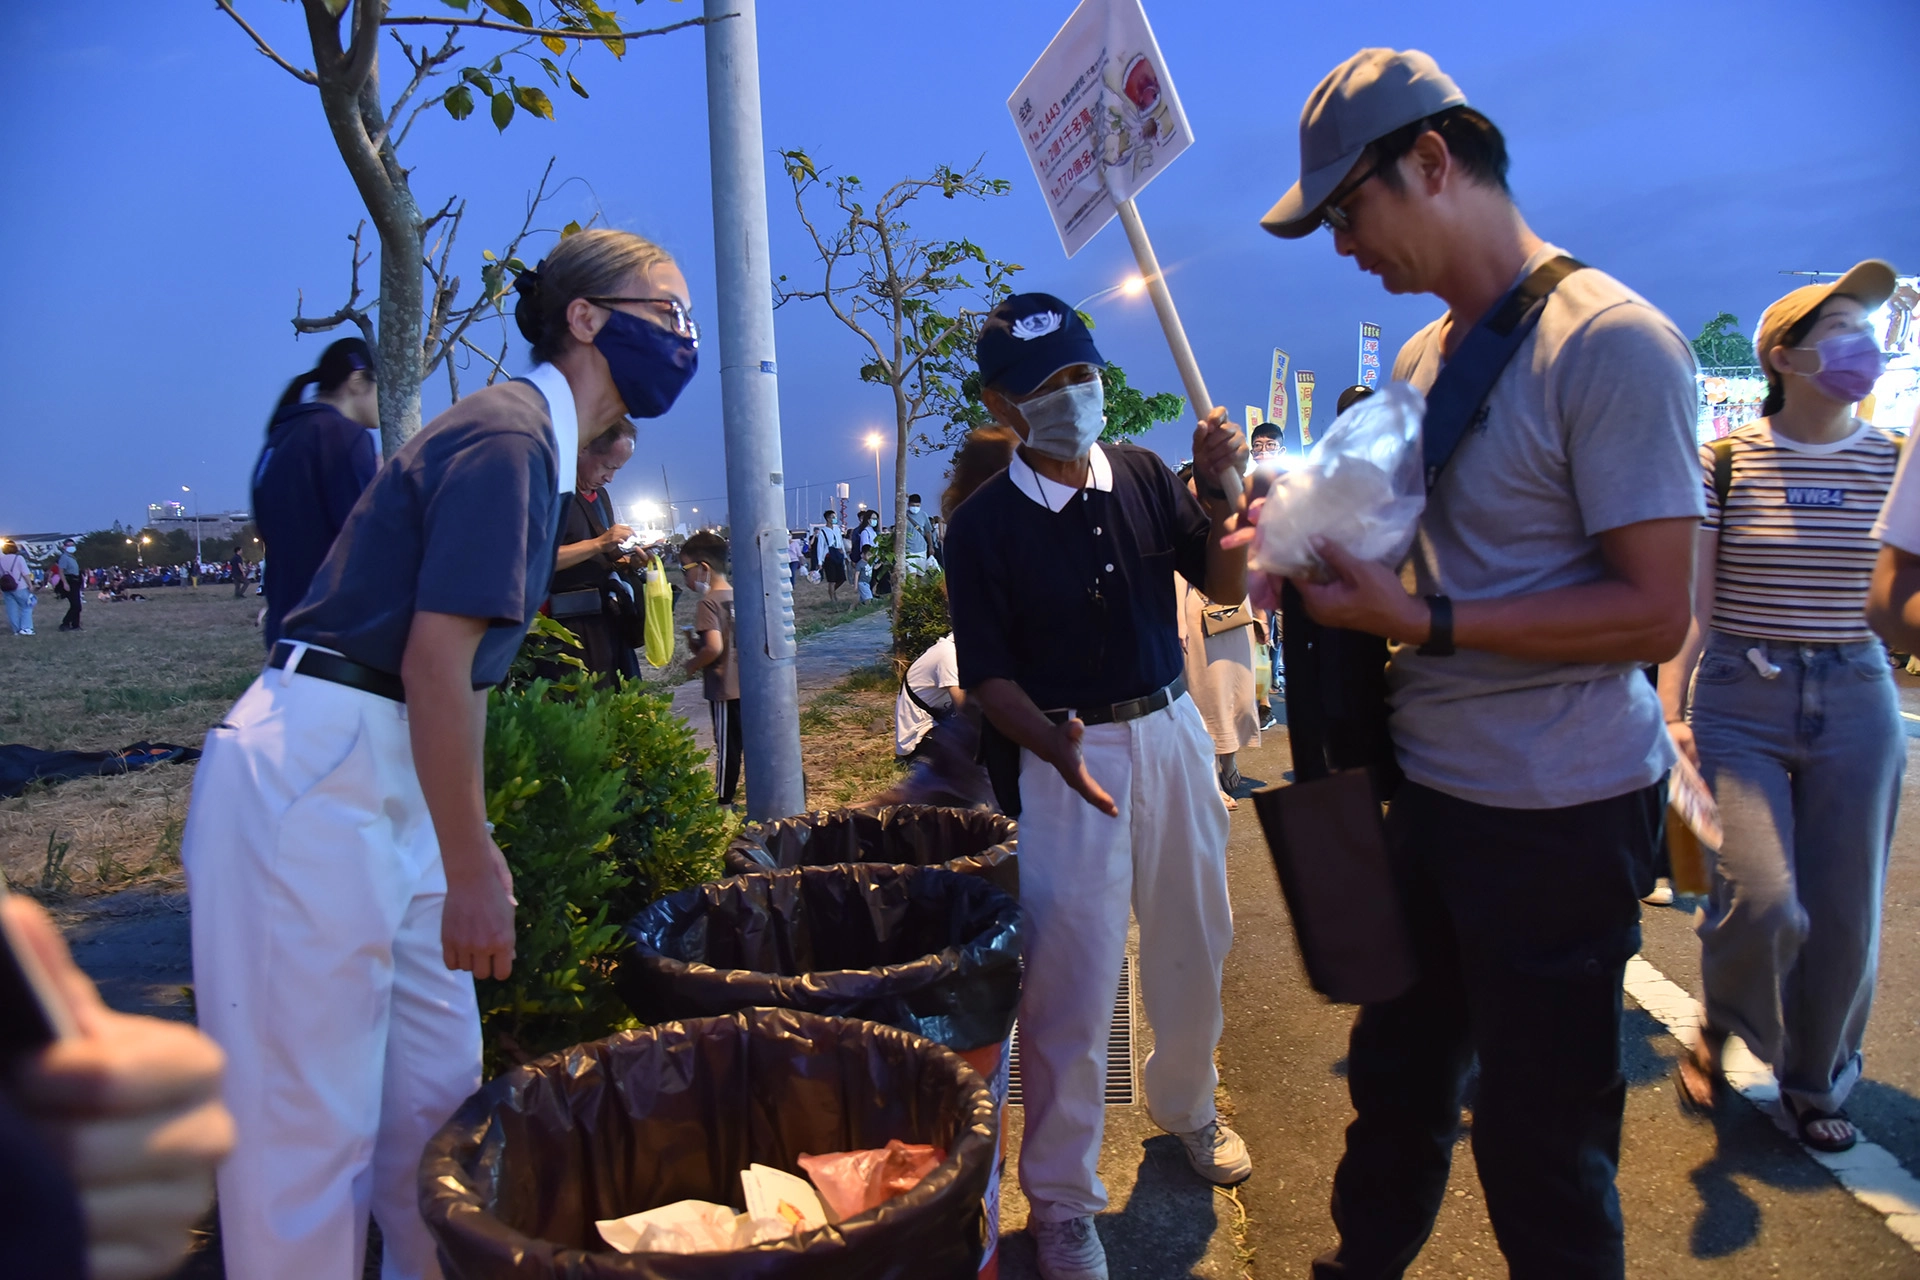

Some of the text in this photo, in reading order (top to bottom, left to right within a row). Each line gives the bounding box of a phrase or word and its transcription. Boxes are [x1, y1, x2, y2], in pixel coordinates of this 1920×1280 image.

[1363, 340, 1380, 388] 彈跳乒
[1787, 488, 1842, 506] WW84
